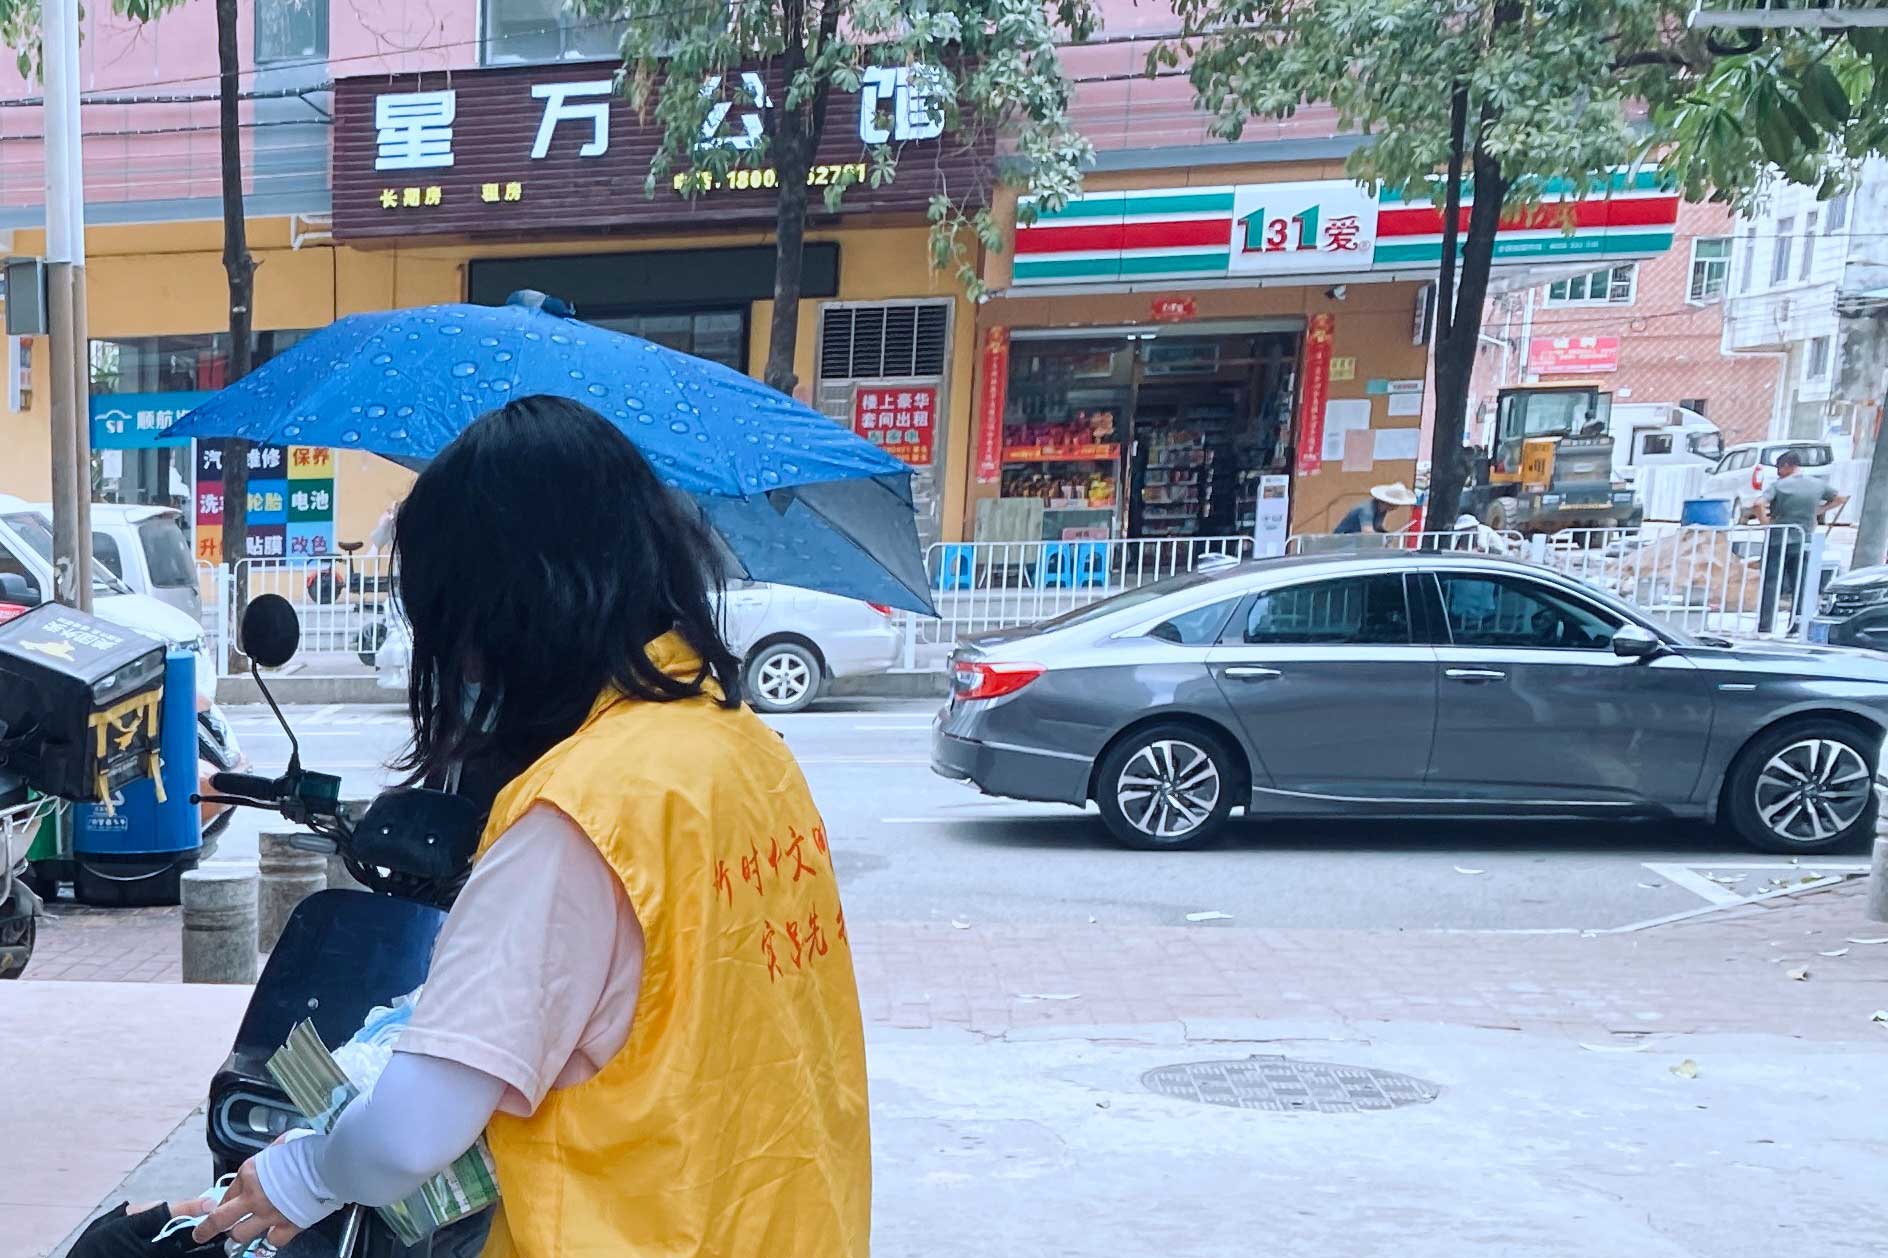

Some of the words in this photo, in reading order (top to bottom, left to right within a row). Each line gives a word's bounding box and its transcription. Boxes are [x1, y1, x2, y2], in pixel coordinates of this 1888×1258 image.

[1237, 204, 1360, 254] 131爱
[863, 392, 929, 410] 楼上豪华
[861, 411, 929, 428] 套间出租
[293, 447, 330, 466] 保养
[246, 491, 283, 512] 轮胎
[291, 489, 329, 511] 电池
[246, 535, 283, 556] 贴膜
[291, 535, 327, 555] 改色
